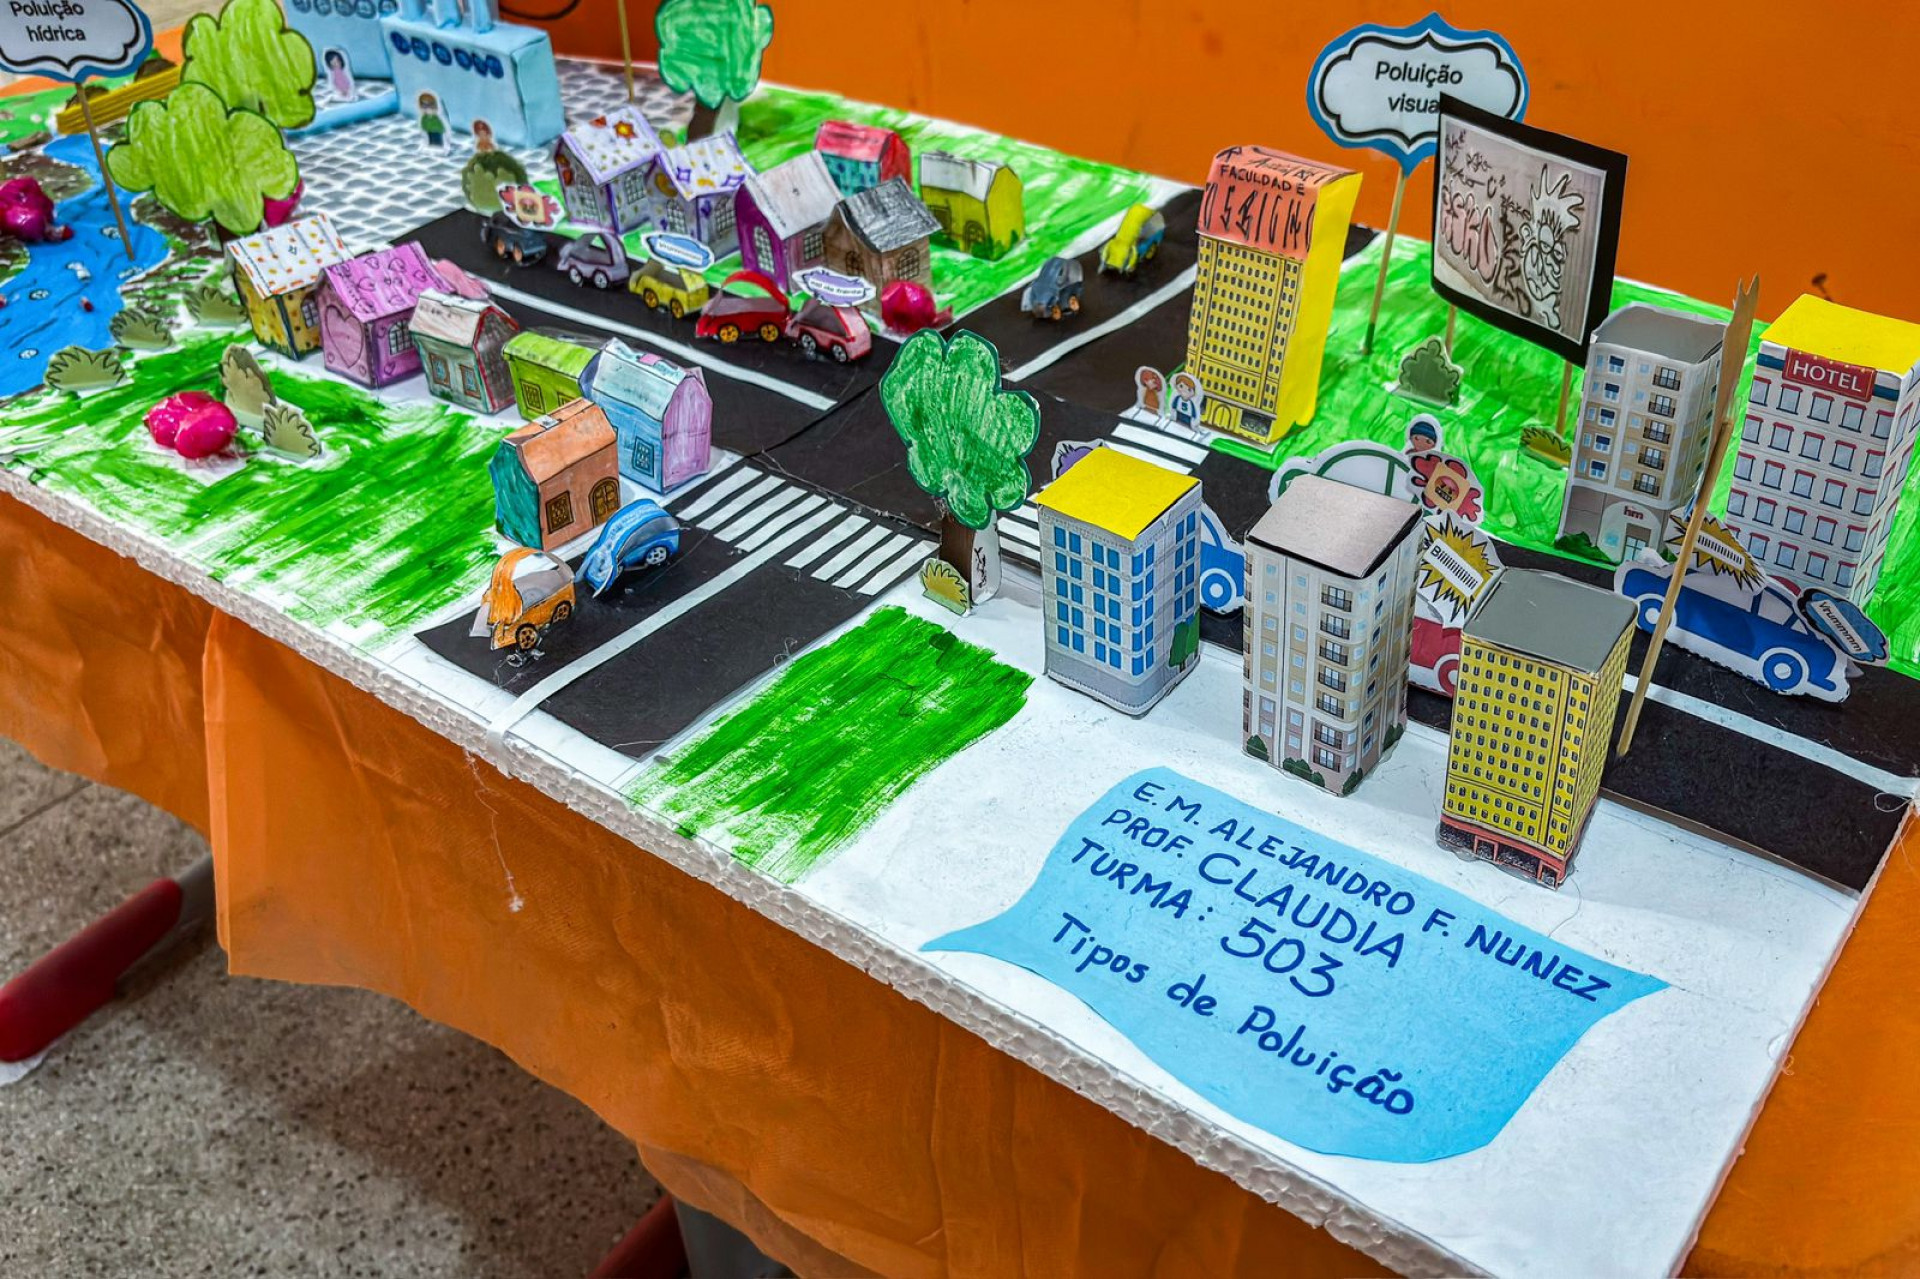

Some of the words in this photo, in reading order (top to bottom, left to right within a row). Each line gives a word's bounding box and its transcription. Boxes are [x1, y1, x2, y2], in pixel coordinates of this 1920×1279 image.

[9, 0, 85, 20] Poluição
[26, 25, 86, 42] hídrica
[1375, 61, 1463, 87] Poluição
[1388, 93, 1440, 114] visua
[1219, 164, 1306, 196] FACULDADE
[1792, 359, 1862, 393] HOTEL
[1101, 808, 1195, 859] PROF.
[1198, 852, 1406, 969] CLAUDIA
[1208, 818, 1415, 916] ALEJANDRO
[1422, 908, 1457, 938] F.
[1464, 924, 1612, 1002] NUNEZ
[1219, 916, 1343, 998] 503
[1052, 911, 1151, 984] Tipos
[1166, 973, 1218, 1017] de
[1236, 1004, 1415, 1116] Poluição
